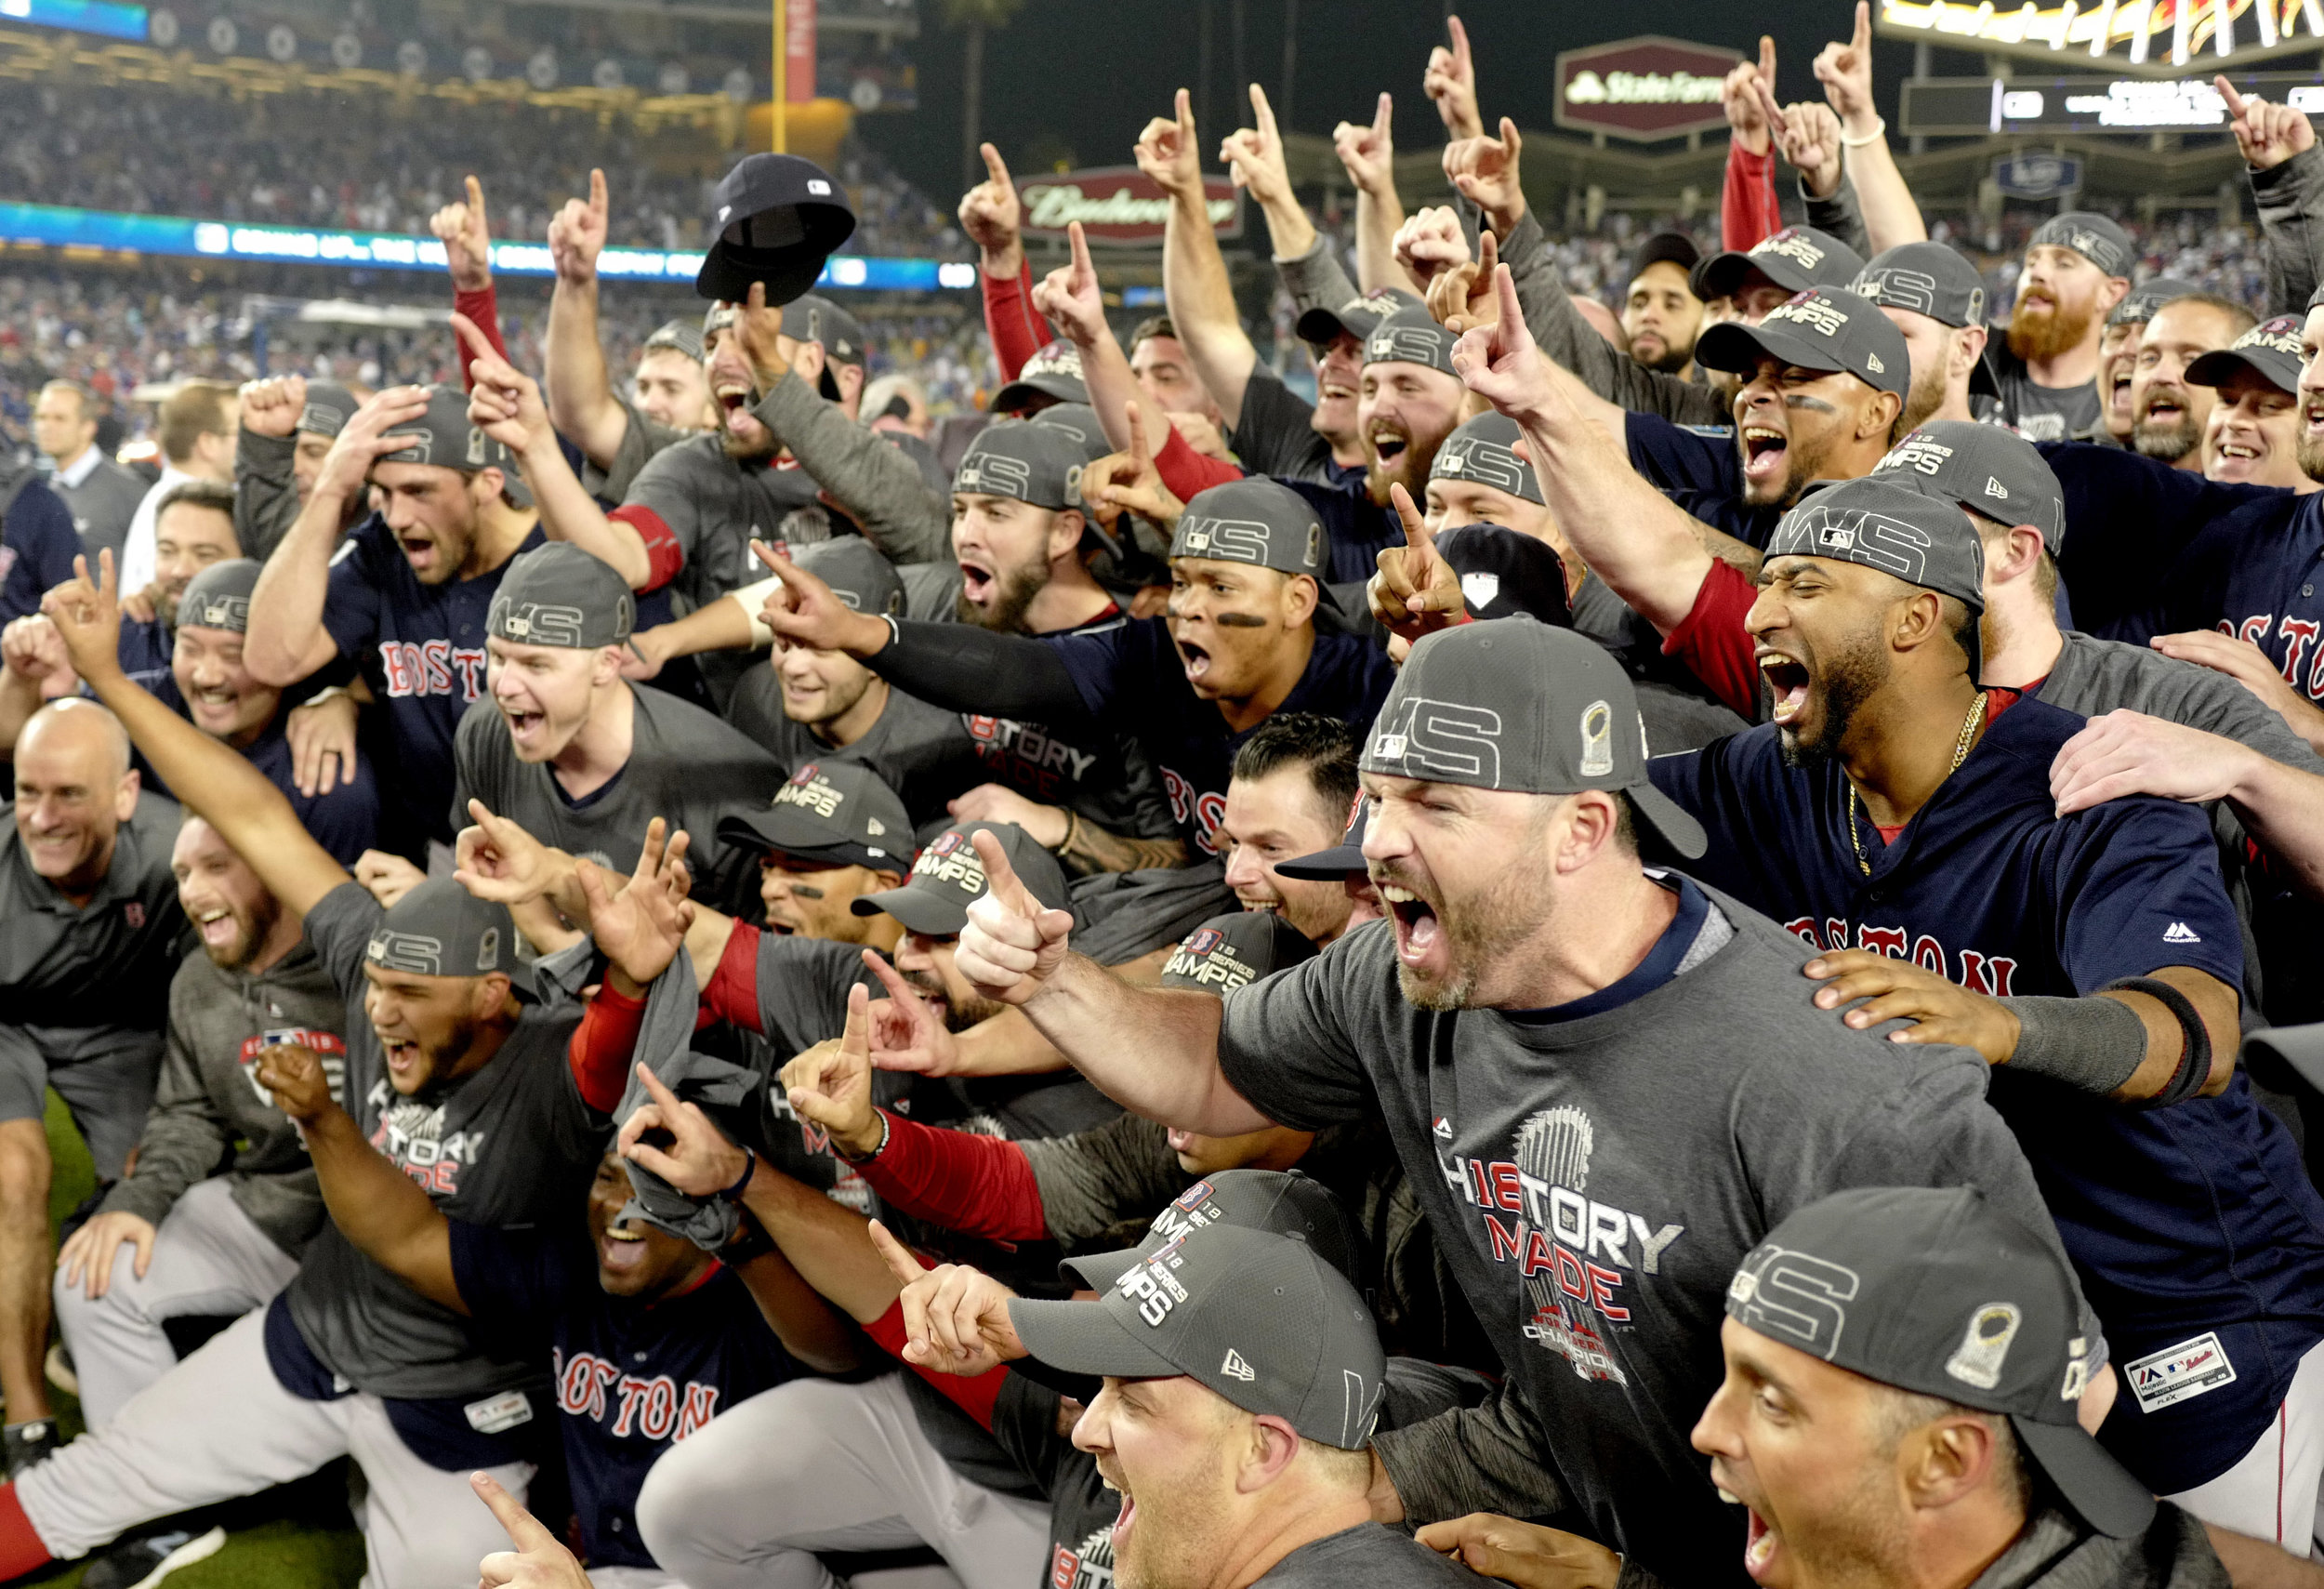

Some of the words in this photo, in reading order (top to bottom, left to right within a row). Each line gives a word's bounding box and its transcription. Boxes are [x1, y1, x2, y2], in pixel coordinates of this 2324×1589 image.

[378, 638, 488, 704] BOST
[1149, 1260, 1188, 1304] SERIES
[1165, 1251, 1183, 1269] 18
[1484, 1214, 1631, 1321] MADE
[1116, 1263, 1174, 1328] MPS
